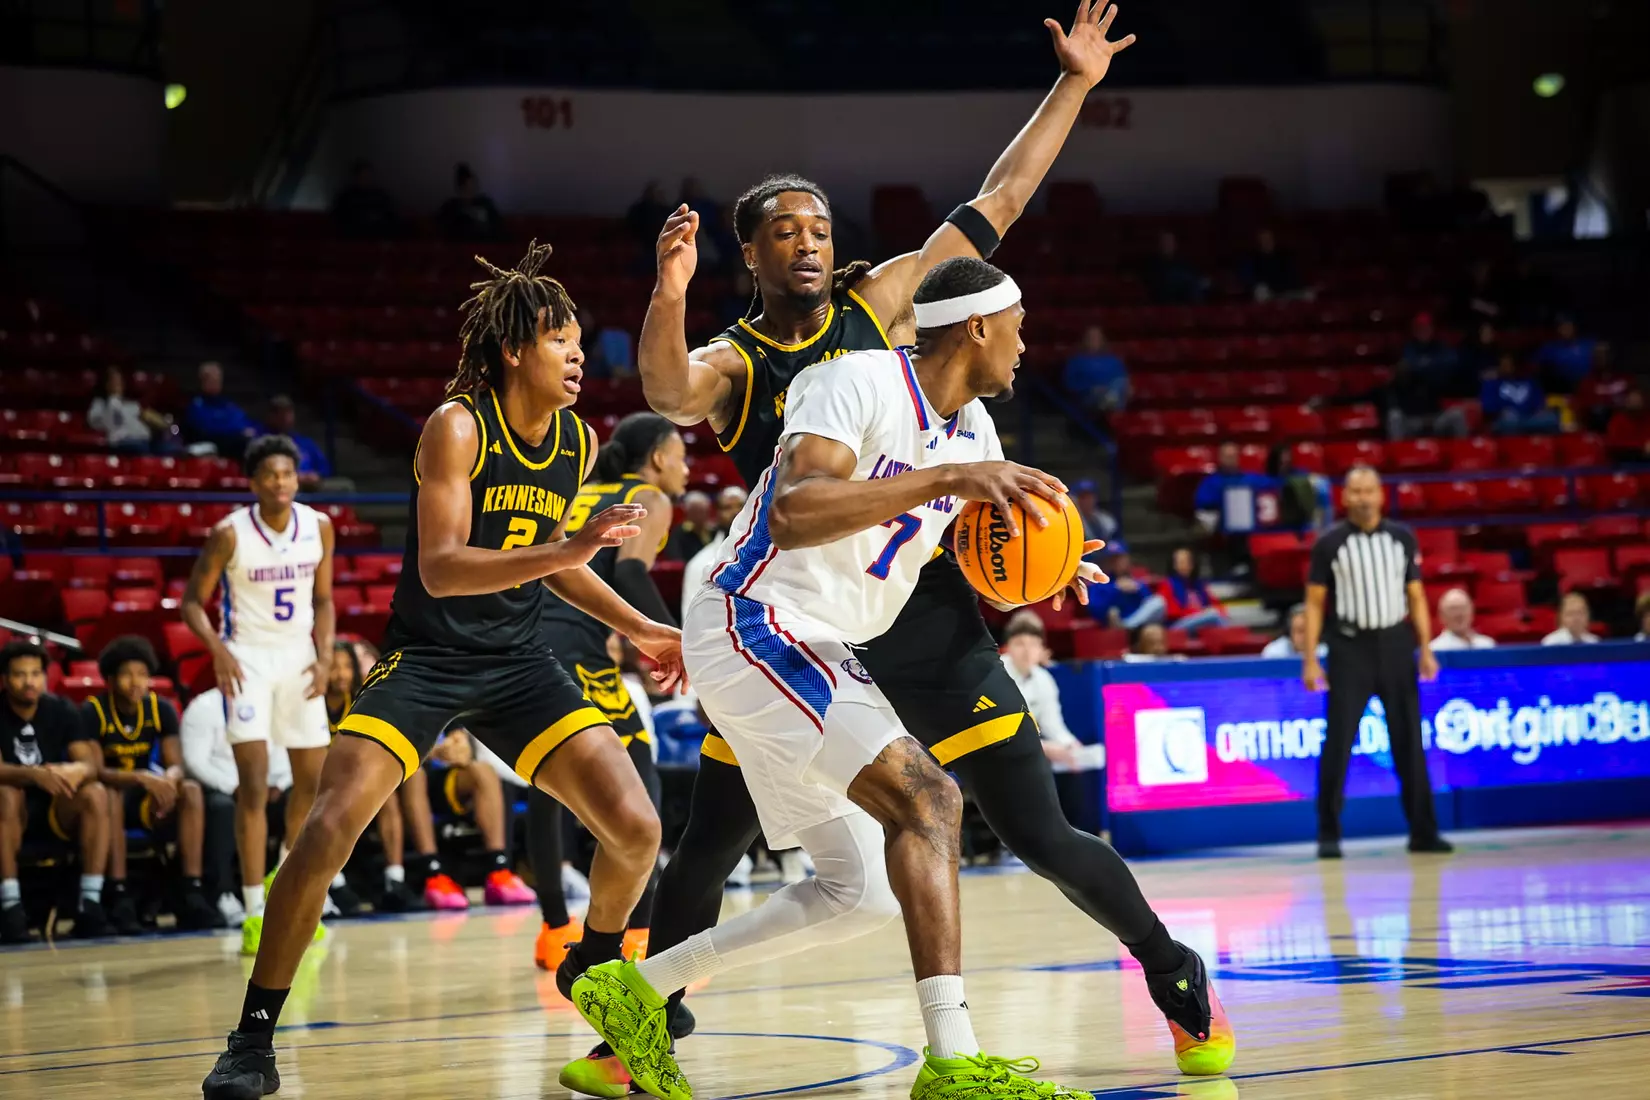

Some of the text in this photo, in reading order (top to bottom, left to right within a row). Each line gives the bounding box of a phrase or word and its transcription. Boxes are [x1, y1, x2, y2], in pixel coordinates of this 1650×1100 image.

[521, 96, 574, 131] 101
[482, 484, 567, 523] KENNESAW
[865, 511, 923, 581] 7
[274, 587, 296, 622] 5
